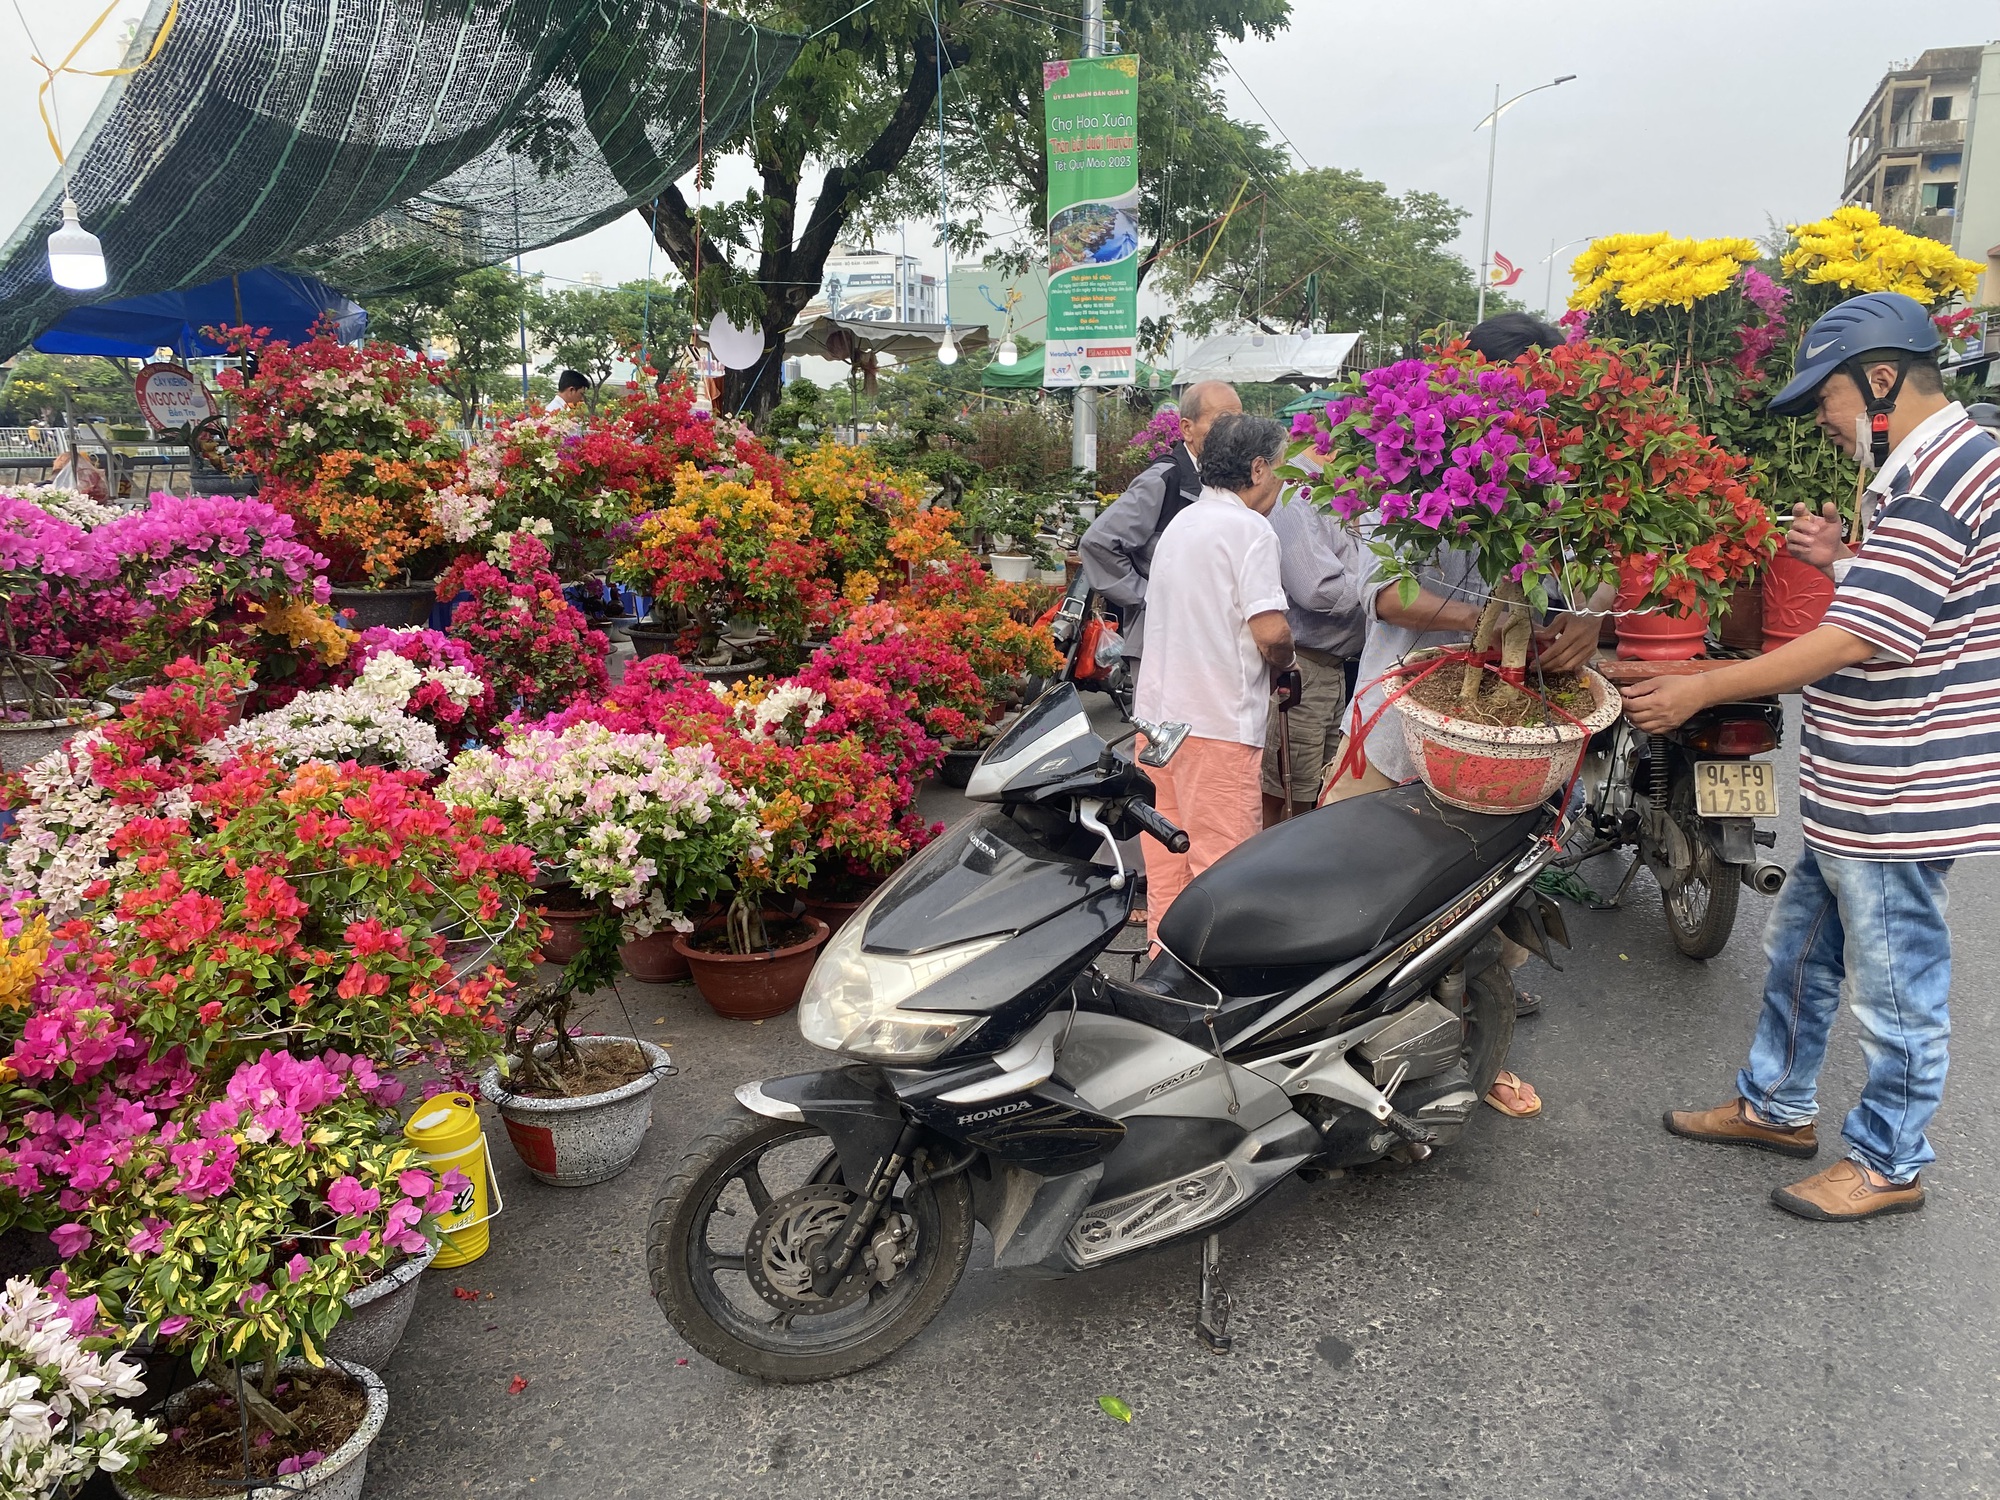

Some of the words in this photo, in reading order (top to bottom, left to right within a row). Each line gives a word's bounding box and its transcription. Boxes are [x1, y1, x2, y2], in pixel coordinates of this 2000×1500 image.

[1052, 117, 1072, 133] Chợ
[1076, 114, 1098, 129] Hoa
[1102, 113, 1133, 127] Xuân
[1054, 160, 1067, 171] Tết
[1086, 157, 1106, 168] Mão
[1109, 156, 1131, 167] 2023
[1707, 765, 1764, 786] 94-F9
[1709, 789, 1766, 813] 1758
[957, 1100, 1032, 1125] HONDA
